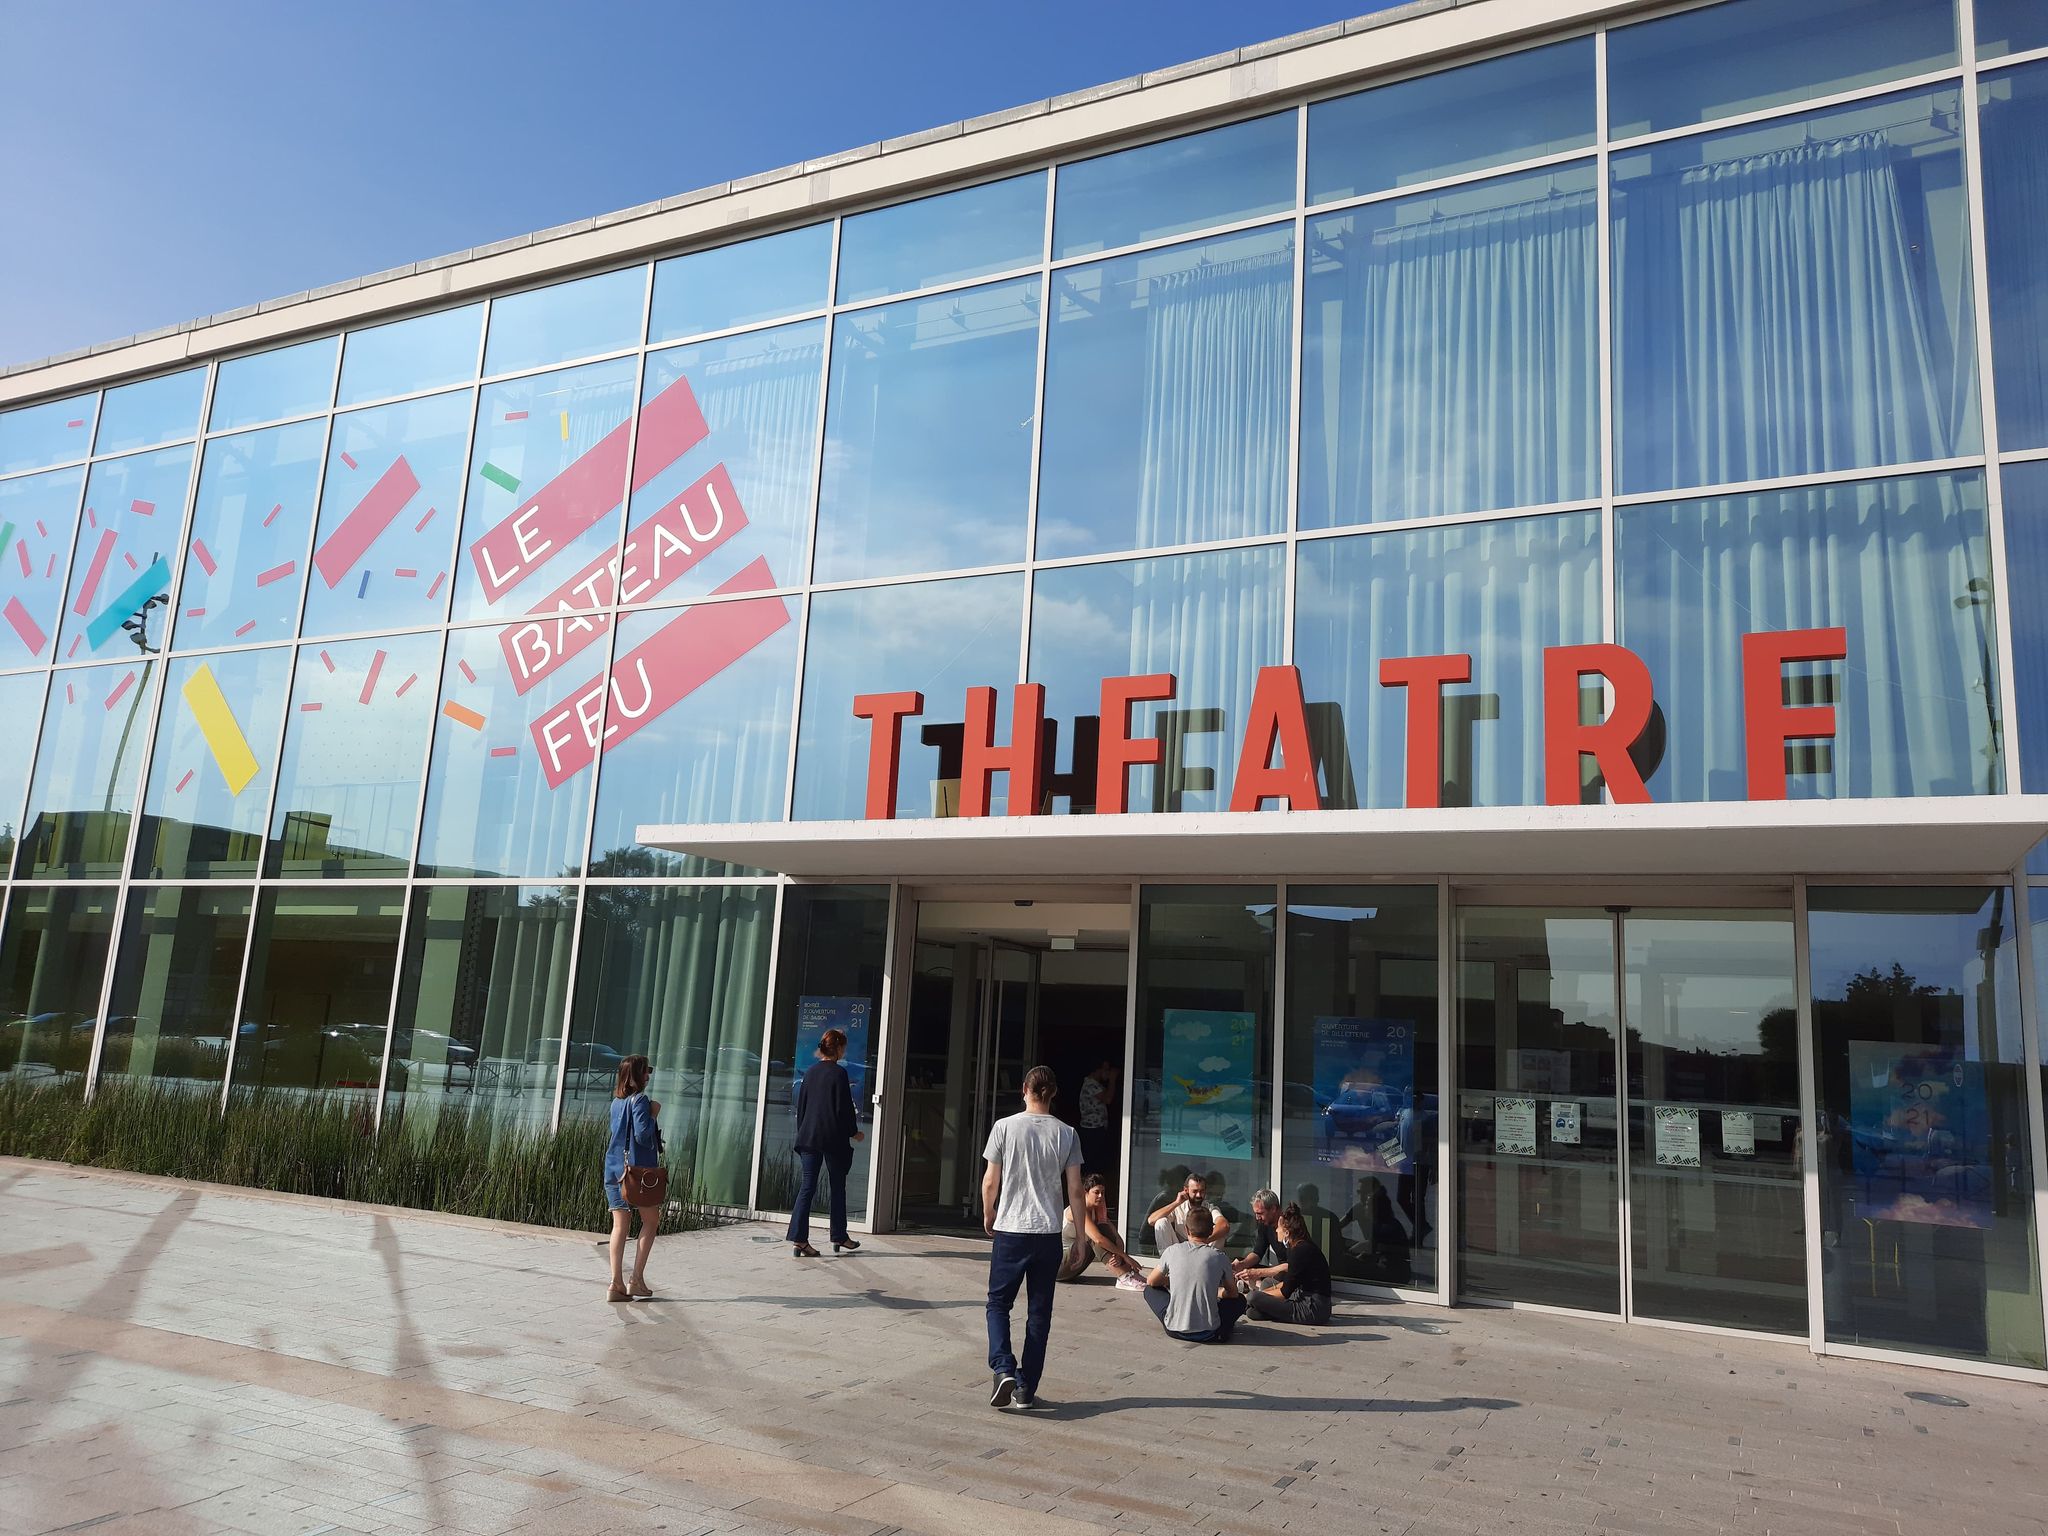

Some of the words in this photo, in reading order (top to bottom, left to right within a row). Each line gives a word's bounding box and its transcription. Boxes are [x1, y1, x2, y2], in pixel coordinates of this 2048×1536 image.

[481, 504, 552, 589] LE
[510, 482, 725, 680] BATEAU
[541, 657, 655, 773] FEU
[851, 1003, 865, 1014] 20
[851, 1018, 862, 1028] 21
[1386, 1025, 1406, 1039] 20
[1388, 1042, 1404, 1056] 21
[1902, 1083, 1933, 1101] 20
[1905, 1108, 1931, 1126] 21
